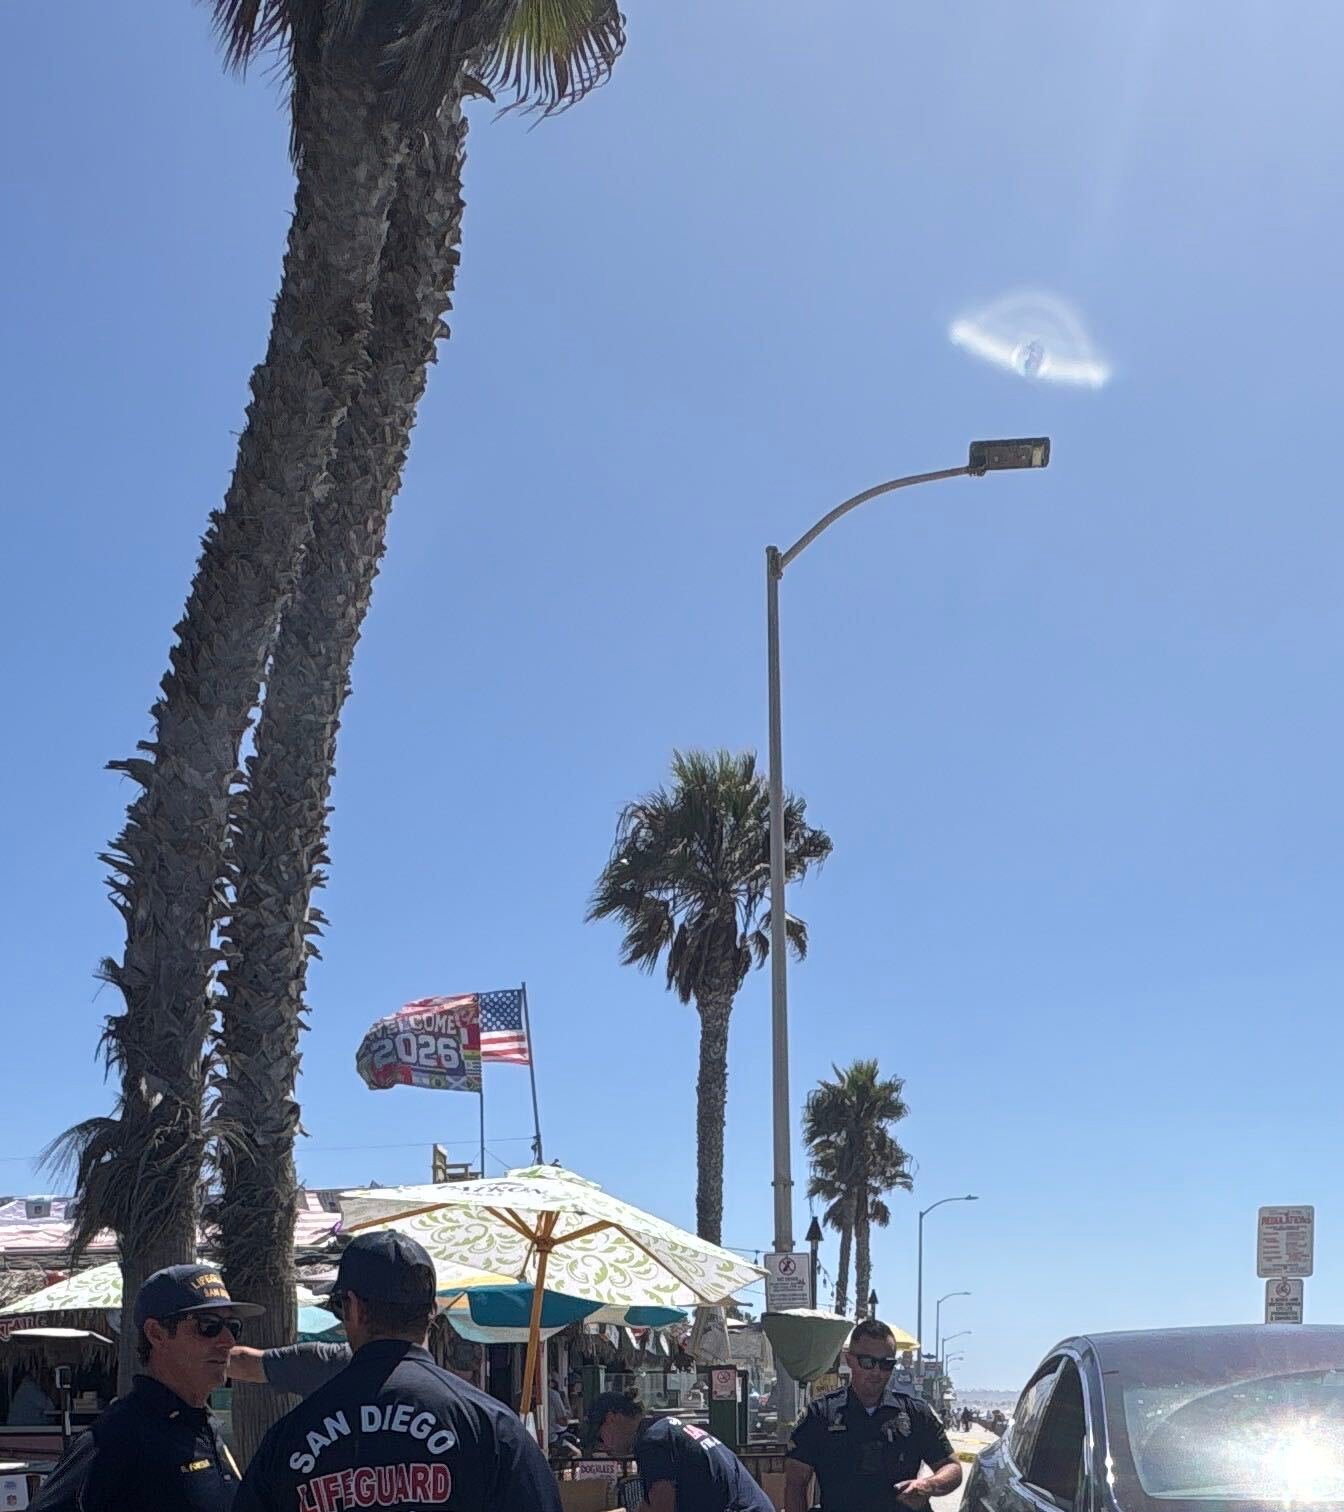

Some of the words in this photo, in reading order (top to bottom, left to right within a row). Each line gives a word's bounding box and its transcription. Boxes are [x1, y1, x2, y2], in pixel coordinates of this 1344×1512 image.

[373, 1032, 460, 1069] 2026
[289, 1410, 352, 1474] SAN
[360, 1404, 456, 1455] DIEGO
